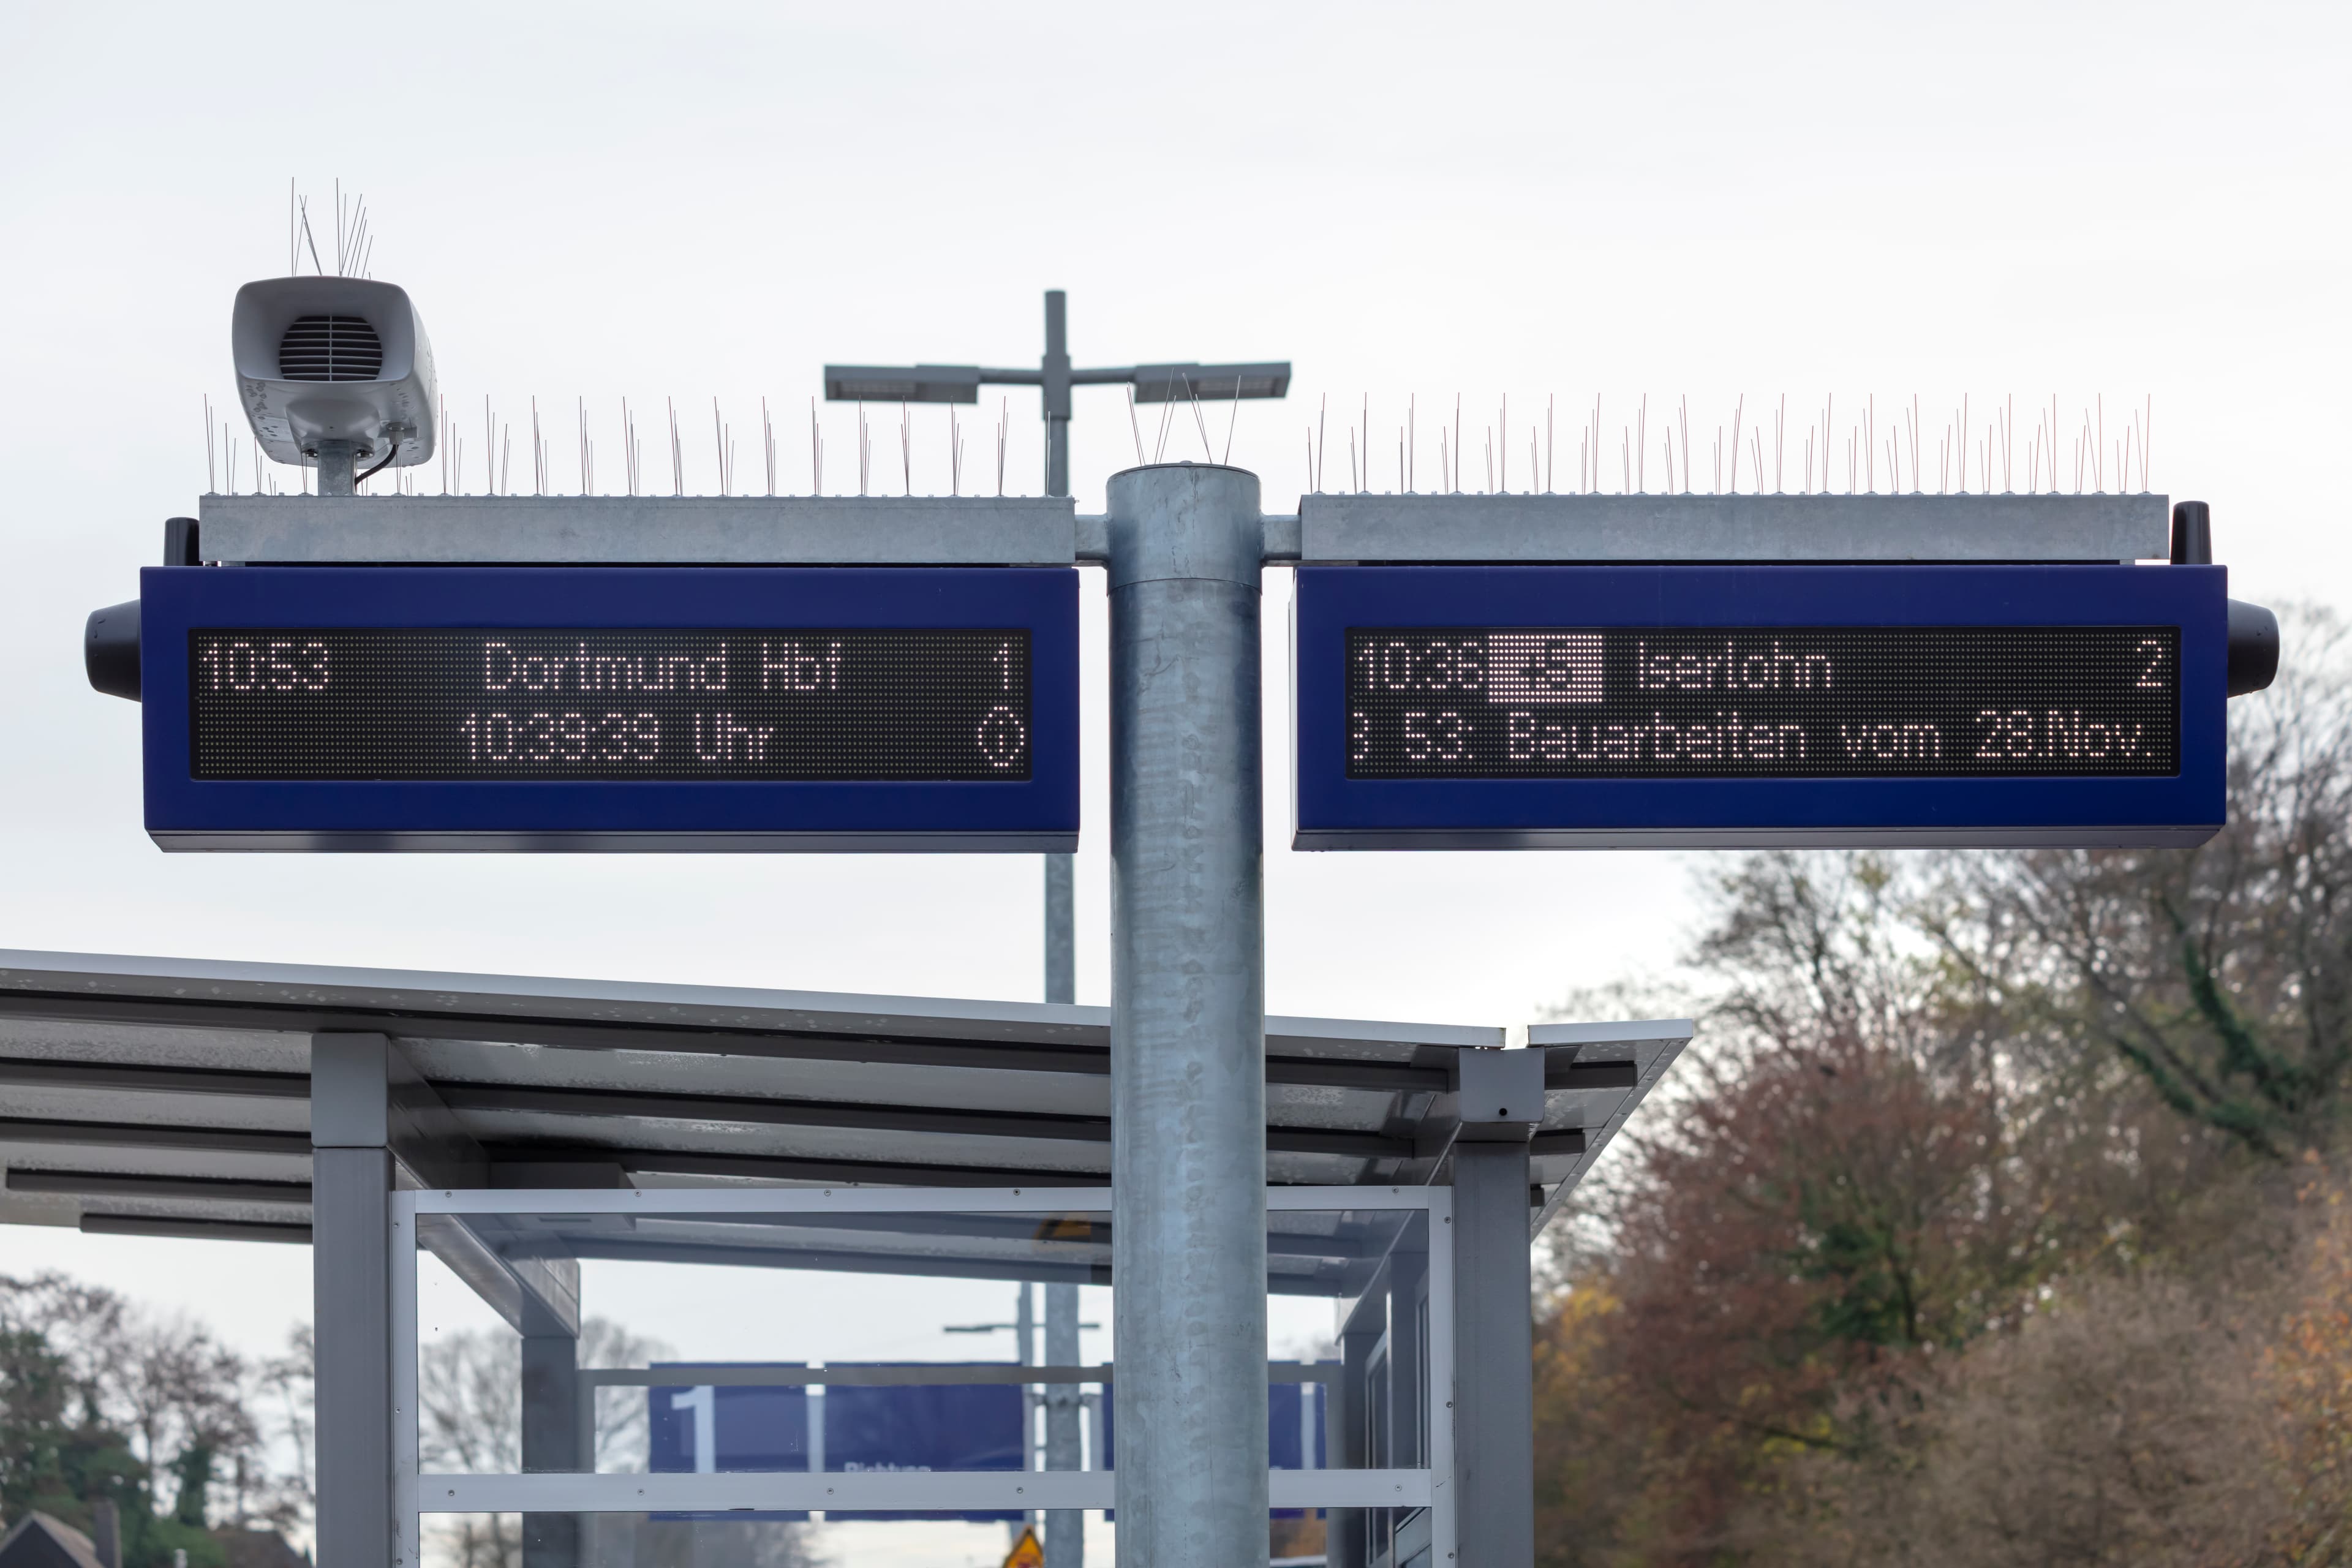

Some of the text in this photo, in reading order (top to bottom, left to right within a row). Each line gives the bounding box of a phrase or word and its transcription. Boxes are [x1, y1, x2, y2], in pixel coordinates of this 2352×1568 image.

[203, 643, 1009, 690] 10:53 Dortmund Hbf 1
[1358, 641, 1483, 690] 10:36
[1639, 641, 1831, 688] Iserlohn
[2136, 640, 2162, 687] 2
[461, 713, 774, 760] 10:39:39 Uhr
[1509, 712, 1804, 759] Bauarbeiten
[1841, 725, 1939, 758] vom
